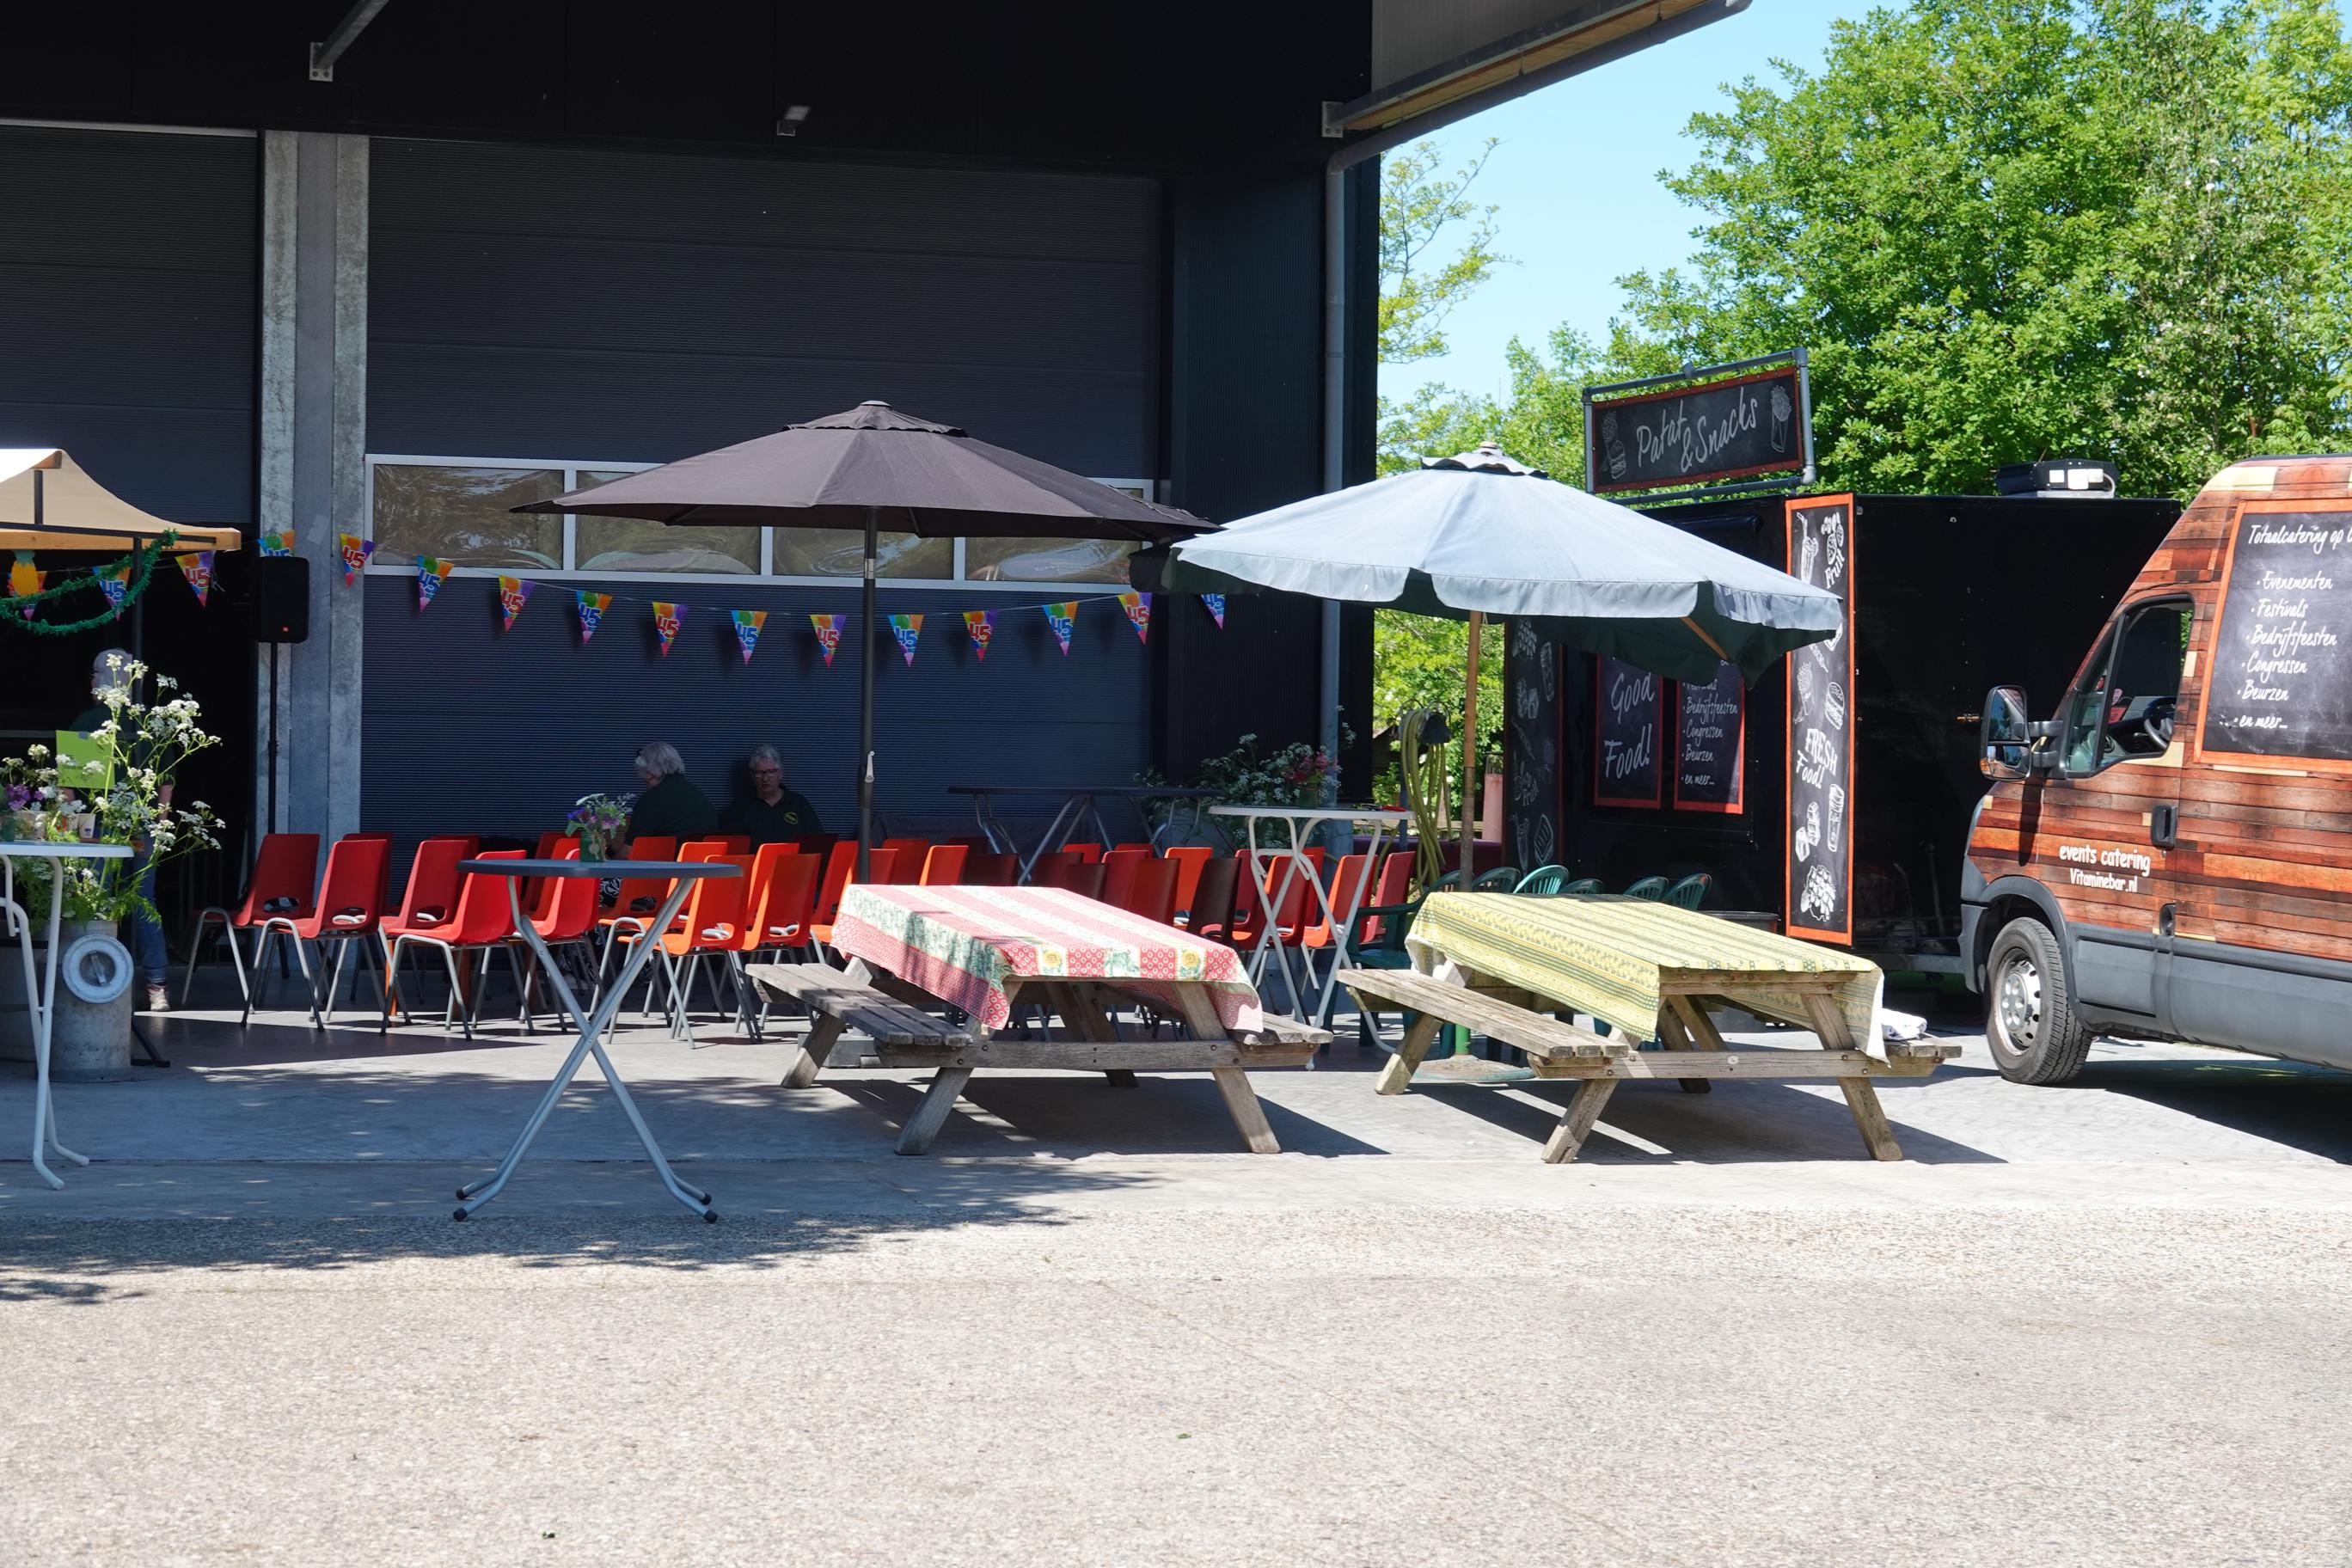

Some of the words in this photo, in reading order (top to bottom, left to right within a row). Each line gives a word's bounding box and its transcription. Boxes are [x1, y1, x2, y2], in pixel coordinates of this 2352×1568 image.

[1636, 400, 1687, 468] Patat
[2248, 524, 2328, 554] Totaalcatering
[2330, 529, 2344, 550] op
[344, 545, 365, 570] 45
[1825, 548, 1846, 590] Fruit
[185, 567, 210, 588] 45
[418, 568, 441, 594] 45
[2263, 571, 2333, 590] Evenementen
[100, 579, 126, 602] 45
[500, 588, 524, 615] 45
[579, 603, 602, 628] 45
[1127, 604, 1149, 627] 45
[2257, 598, 2308, 618] Festivals
[656, 614, 679, 639] 45
[736, 622, 758, 646] 45
[817, 626, 839, 650] 45
[894, 626, 918, 648] 45
[969, 622, 991, 644] 45
[1050, 616, 1073, 638] 45
[2251, 621, 2337, 658] Bedrijfsfeesten
[2247, 651, 2307, 683] Congressen
[1610, 672, 1655, 724] Good
[2242, 679, 2289, 701] Beurzen
[1686, 693, 1738, 725] Bedrijfsfeesten
[2239, 714, 2253, 727] en
[1686, 720, 1724, 747] Congressen
[1604, 723, 1652, 779] Food!
[1685, 744, 1713, 761] Beurzen
[1804, 728, 1838, 776] FRESH
[1685, 774, 1694, 785] en
[1796, 749, 1826, 789] Food!
[2059, 844, 2098, 864] events
[2100, 848, 2151, 877] catering
[2070, 867, 2138, 892] Vitaminebar.nl
